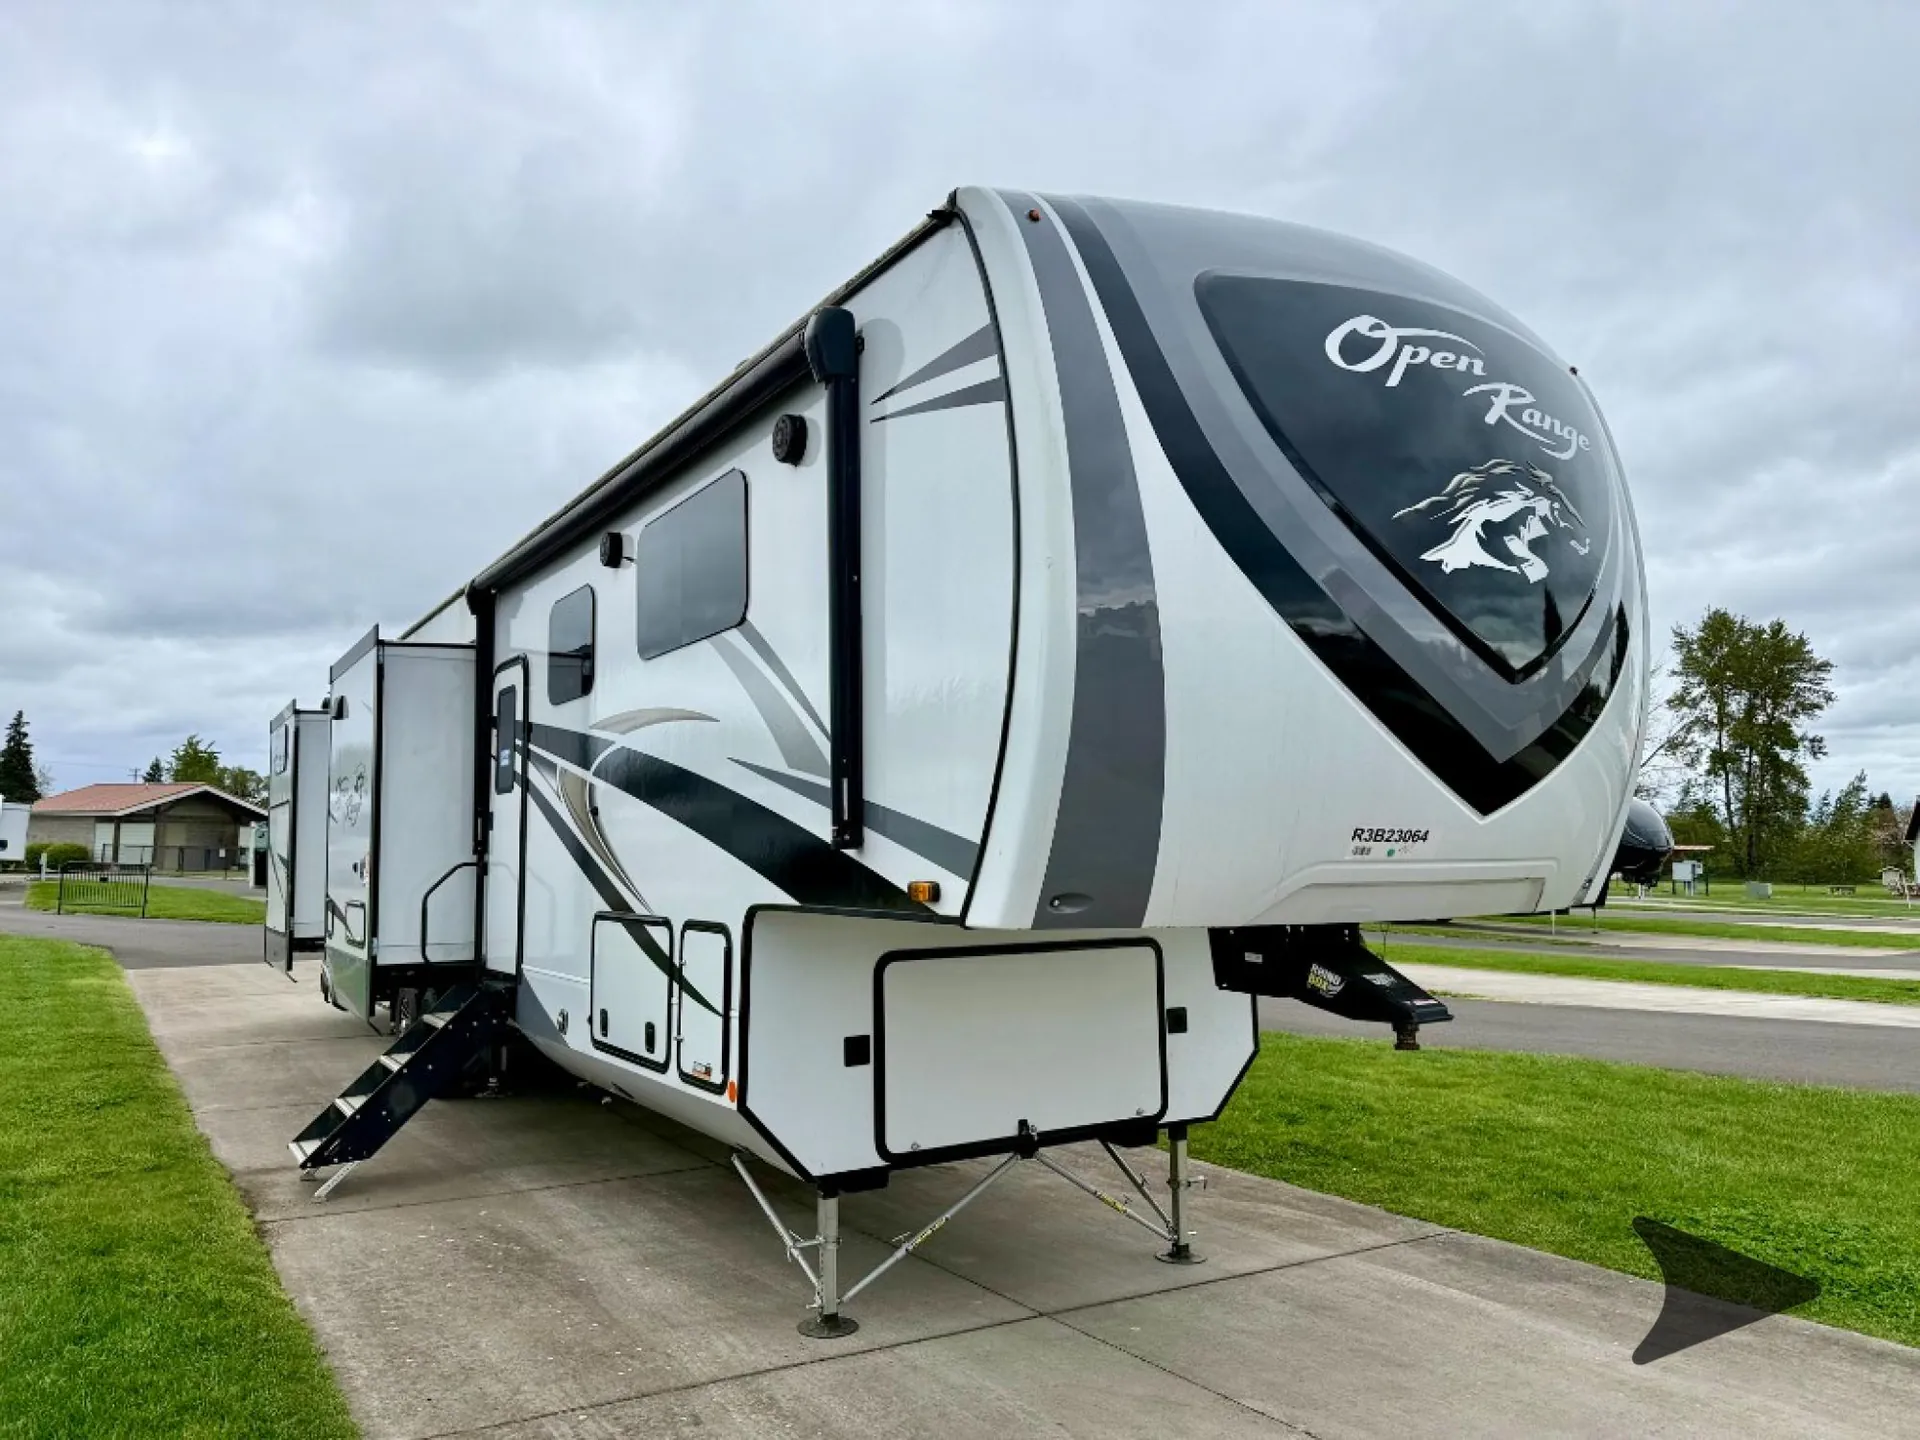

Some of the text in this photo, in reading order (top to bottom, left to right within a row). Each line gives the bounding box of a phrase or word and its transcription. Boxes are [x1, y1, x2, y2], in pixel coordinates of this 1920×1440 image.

[1325, 315, 1486, 387] Open
[1462, 382, 1590, 460] Range
[1351, 827, 1429, 842] R3B23064
